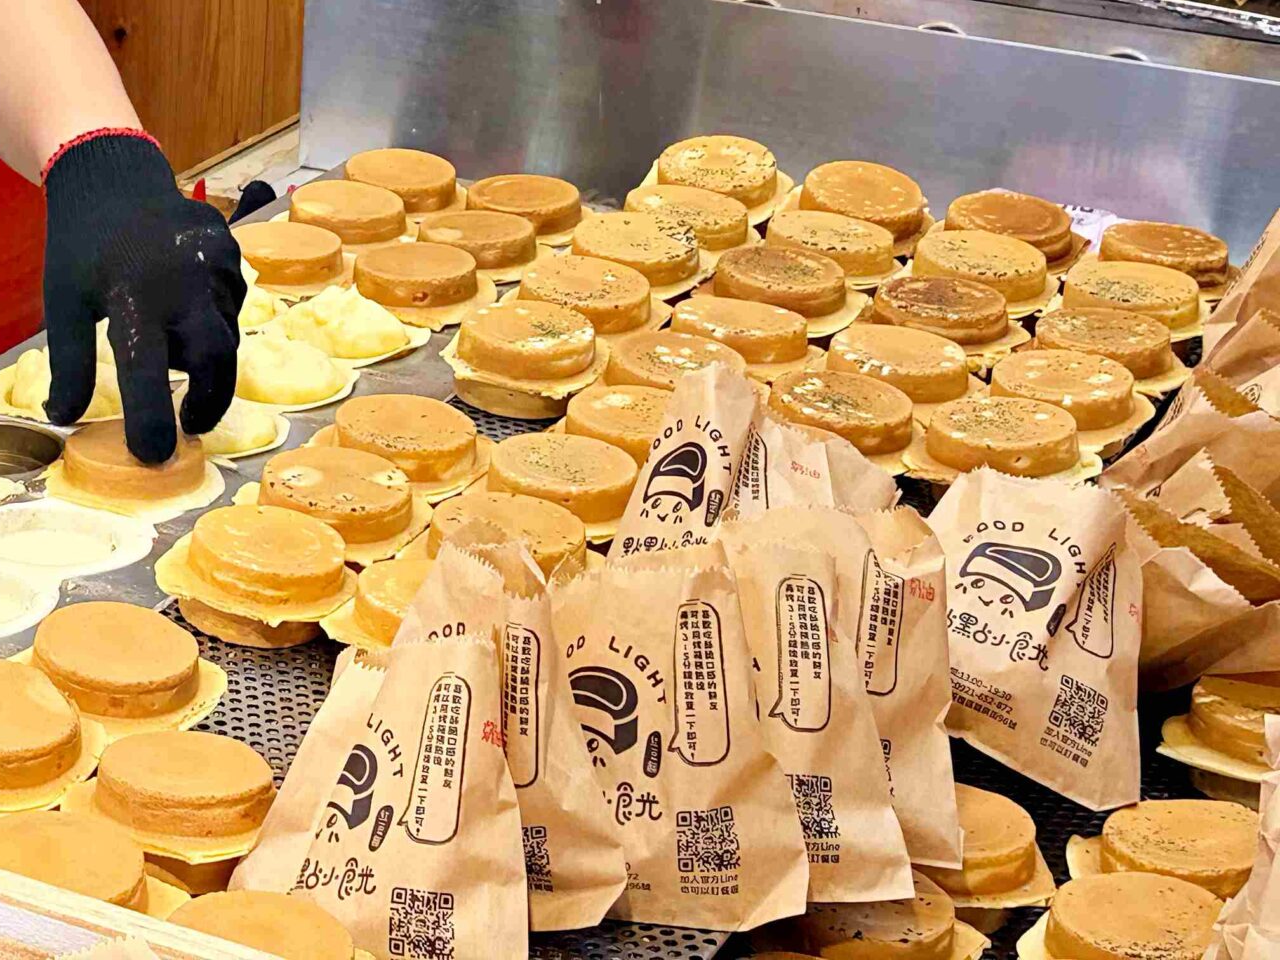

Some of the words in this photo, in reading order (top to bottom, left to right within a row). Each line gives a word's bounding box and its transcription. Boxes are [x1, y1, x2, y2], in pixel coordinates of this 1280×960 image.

[646, 419, 684, 464] OOD
[694, 415, 732, 476] LIGHT
[1048, 527, 1088, 589] LIGH
[608, 635, 668, 704] LIGHT
[365, 712, 405, 778] LIGHT
[626, 882, 652, 892] 96號
